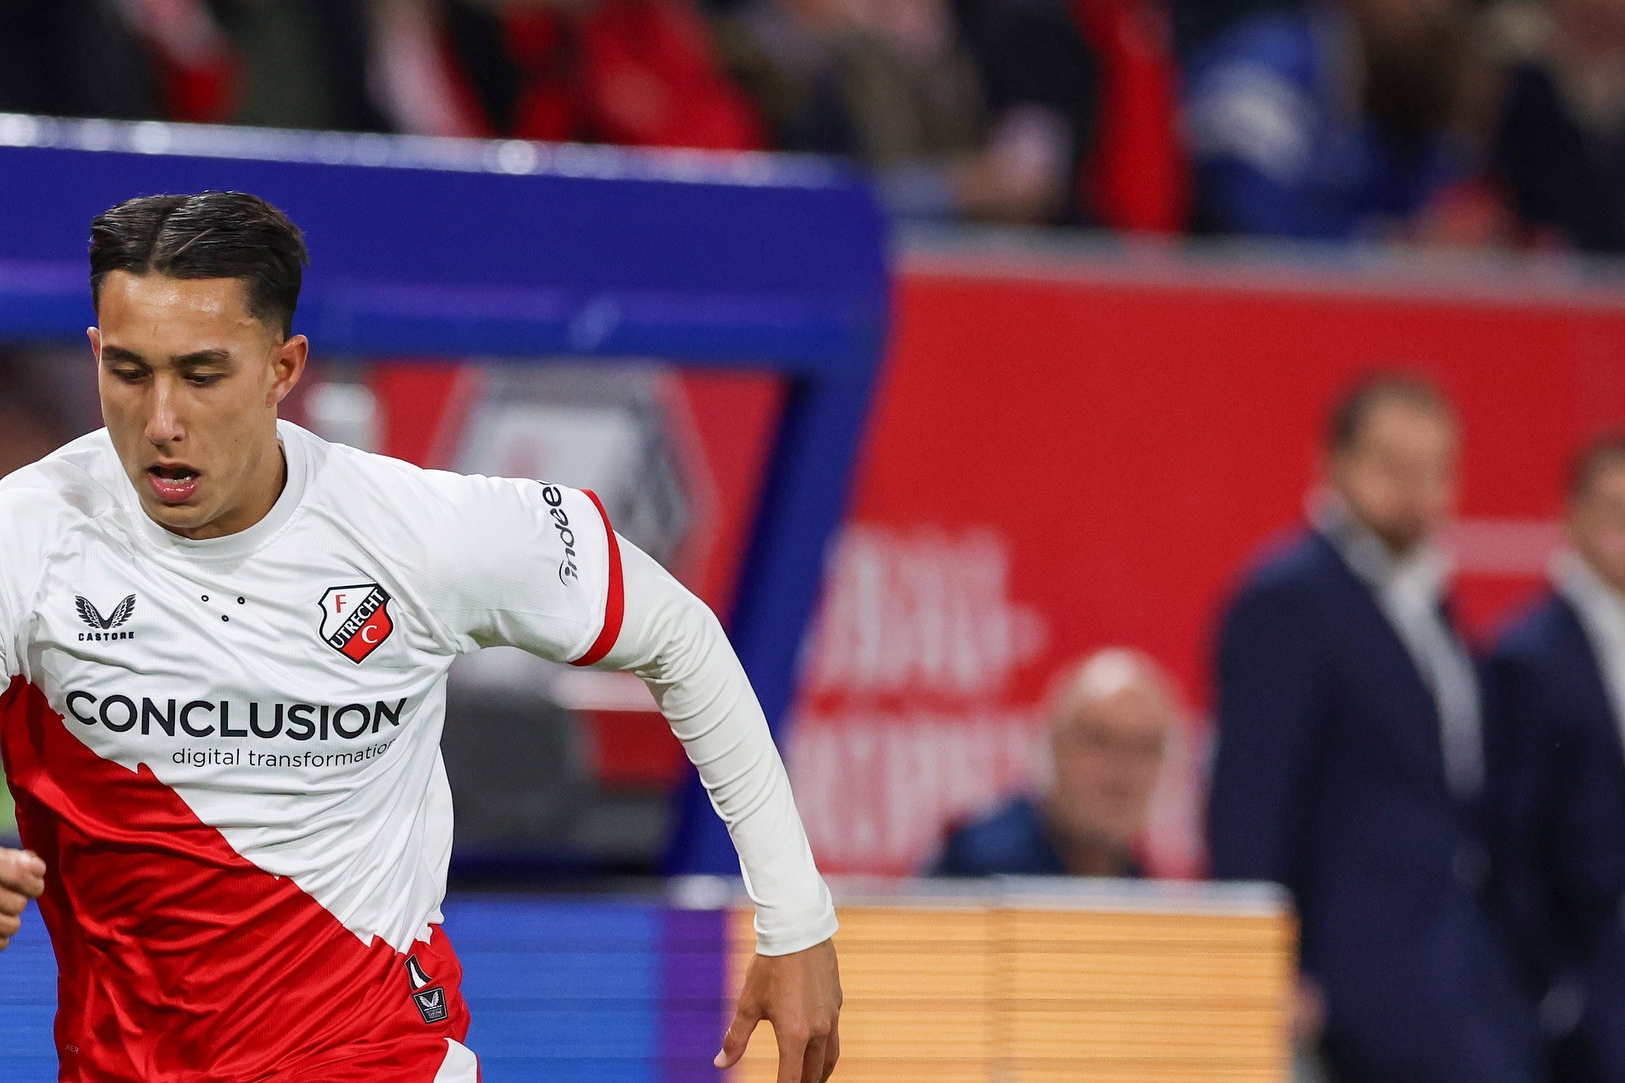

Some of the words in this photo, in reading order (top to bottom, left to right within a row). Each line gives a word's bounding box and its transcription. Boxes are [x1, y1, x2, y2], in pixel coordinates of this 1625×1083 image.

[539, 482, 578, 586] indee
[335, 594, 347, 613] F
[329, 588, 385, 649] UTRECHT
[78, 631, 135, 641] CASTORE
[361, 625, 378, 644] C
[65, 690, 408, 741] CONCLUSION
[172, 748, 240, 768] digital
